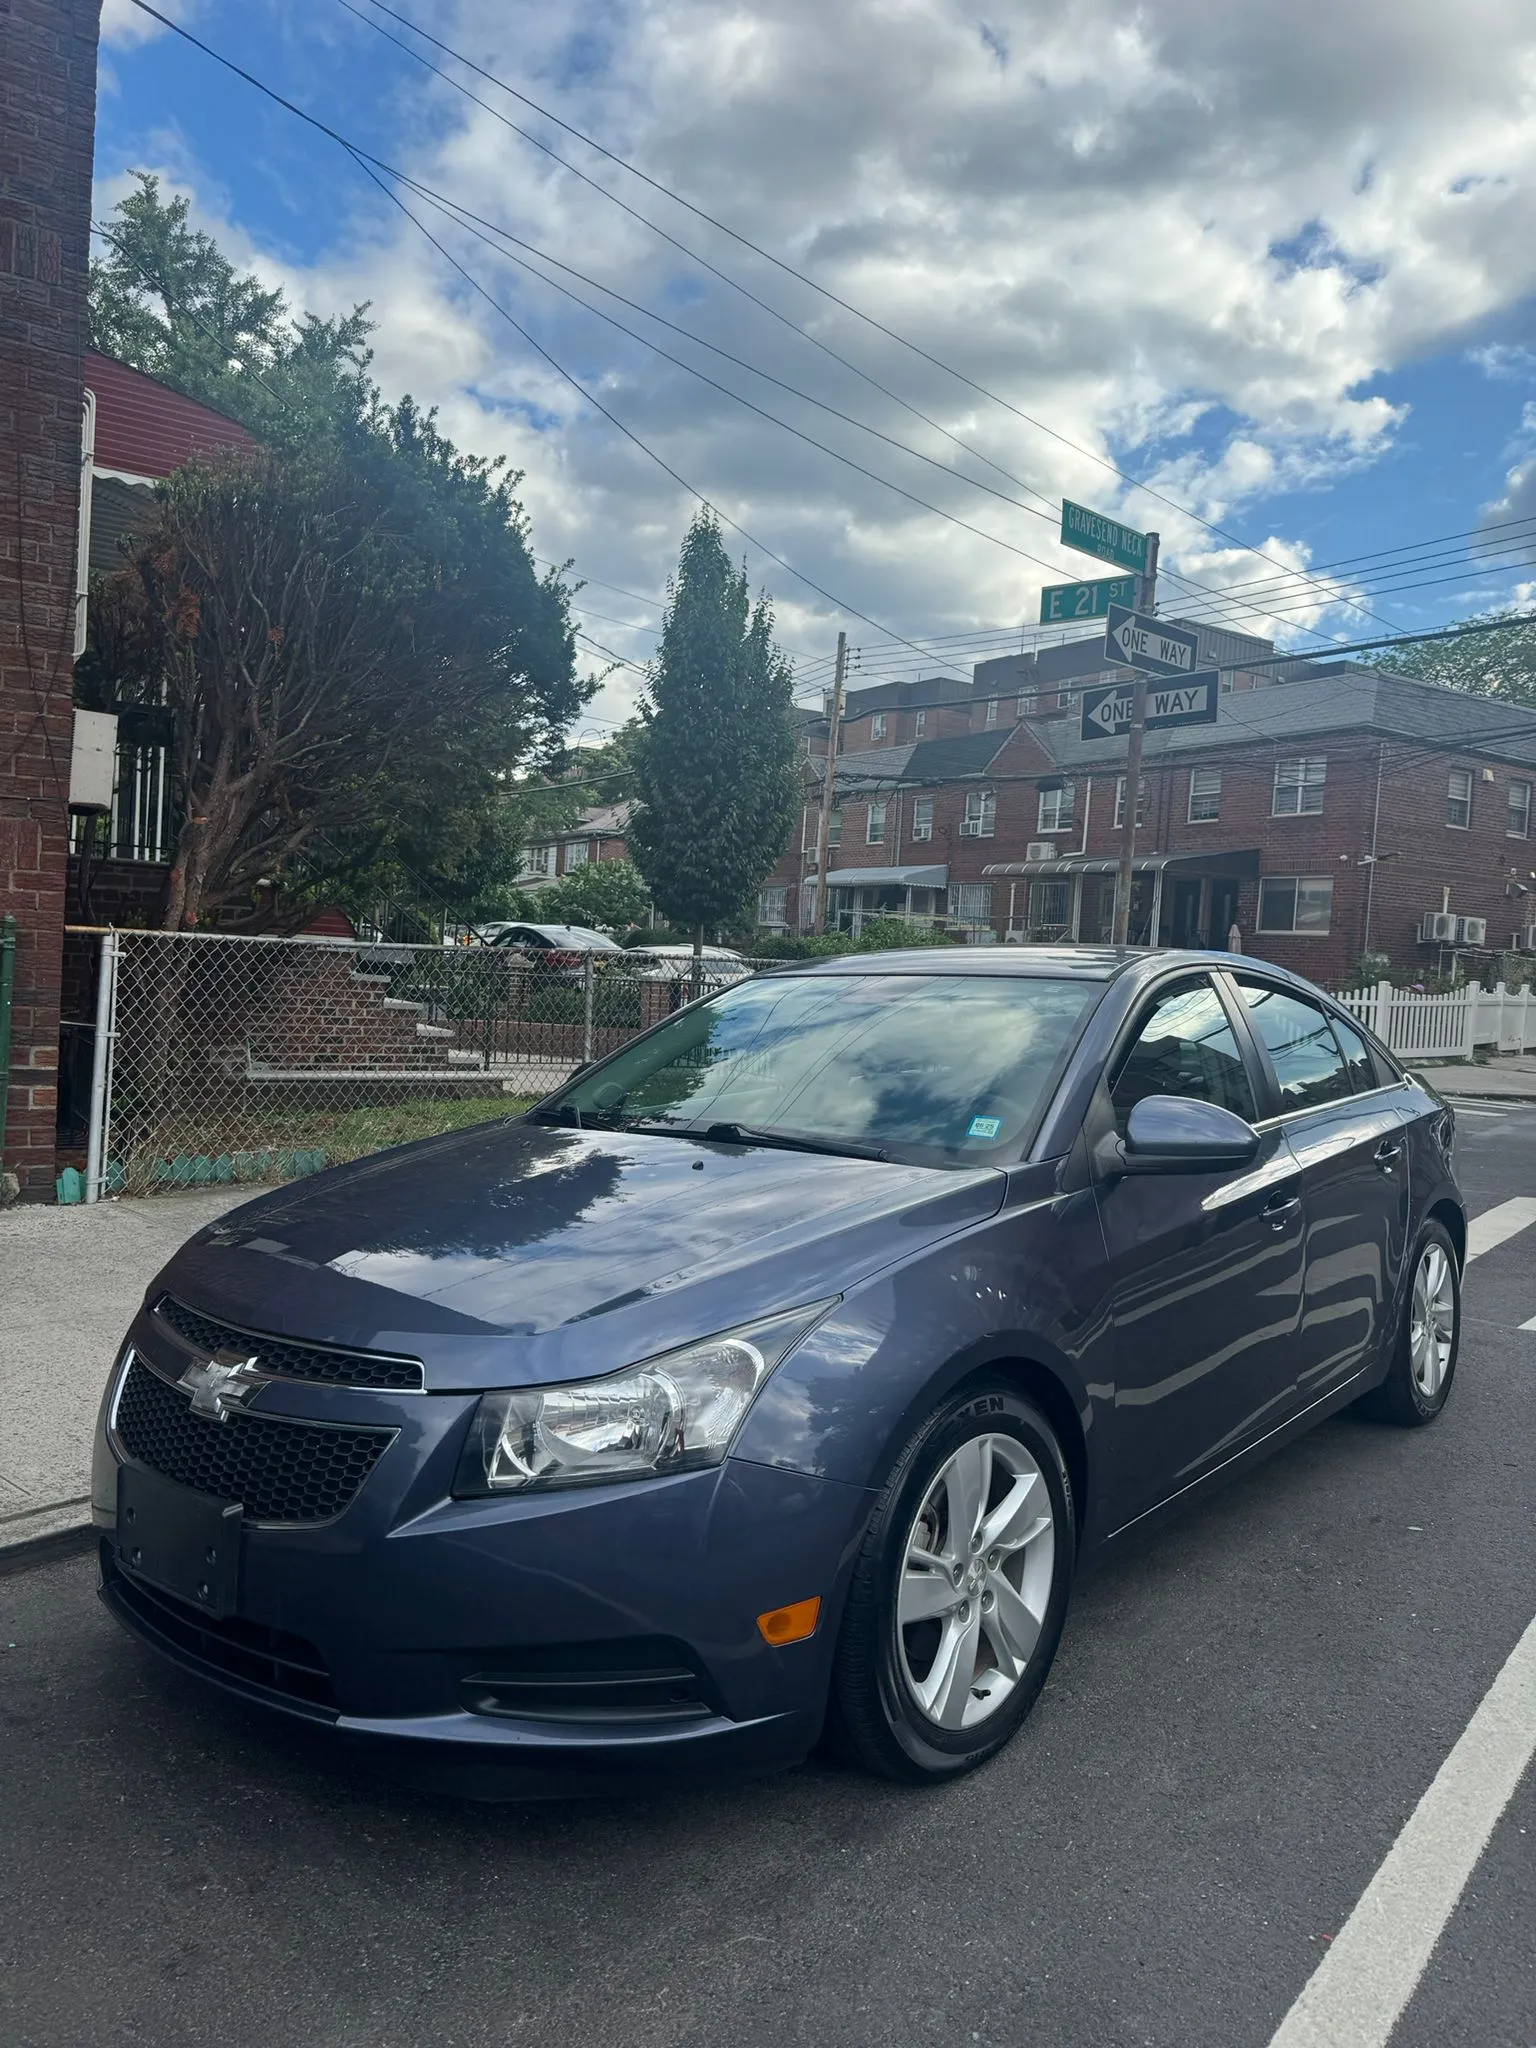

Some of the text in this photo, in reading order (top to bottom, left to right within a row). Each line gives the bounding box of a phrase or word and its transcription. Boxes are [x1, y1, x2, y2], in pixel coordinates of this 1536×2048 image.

[1068, 506, 1143, 558] GRAVESEND NECK
[1096, 543, 1115, 560] ROAD
[1049, 581, 1127, 619] E 21 ST
[1121, 627, 1187, 666] ONE WAY
[1100, 689, 1198, 723] ONE WAY
